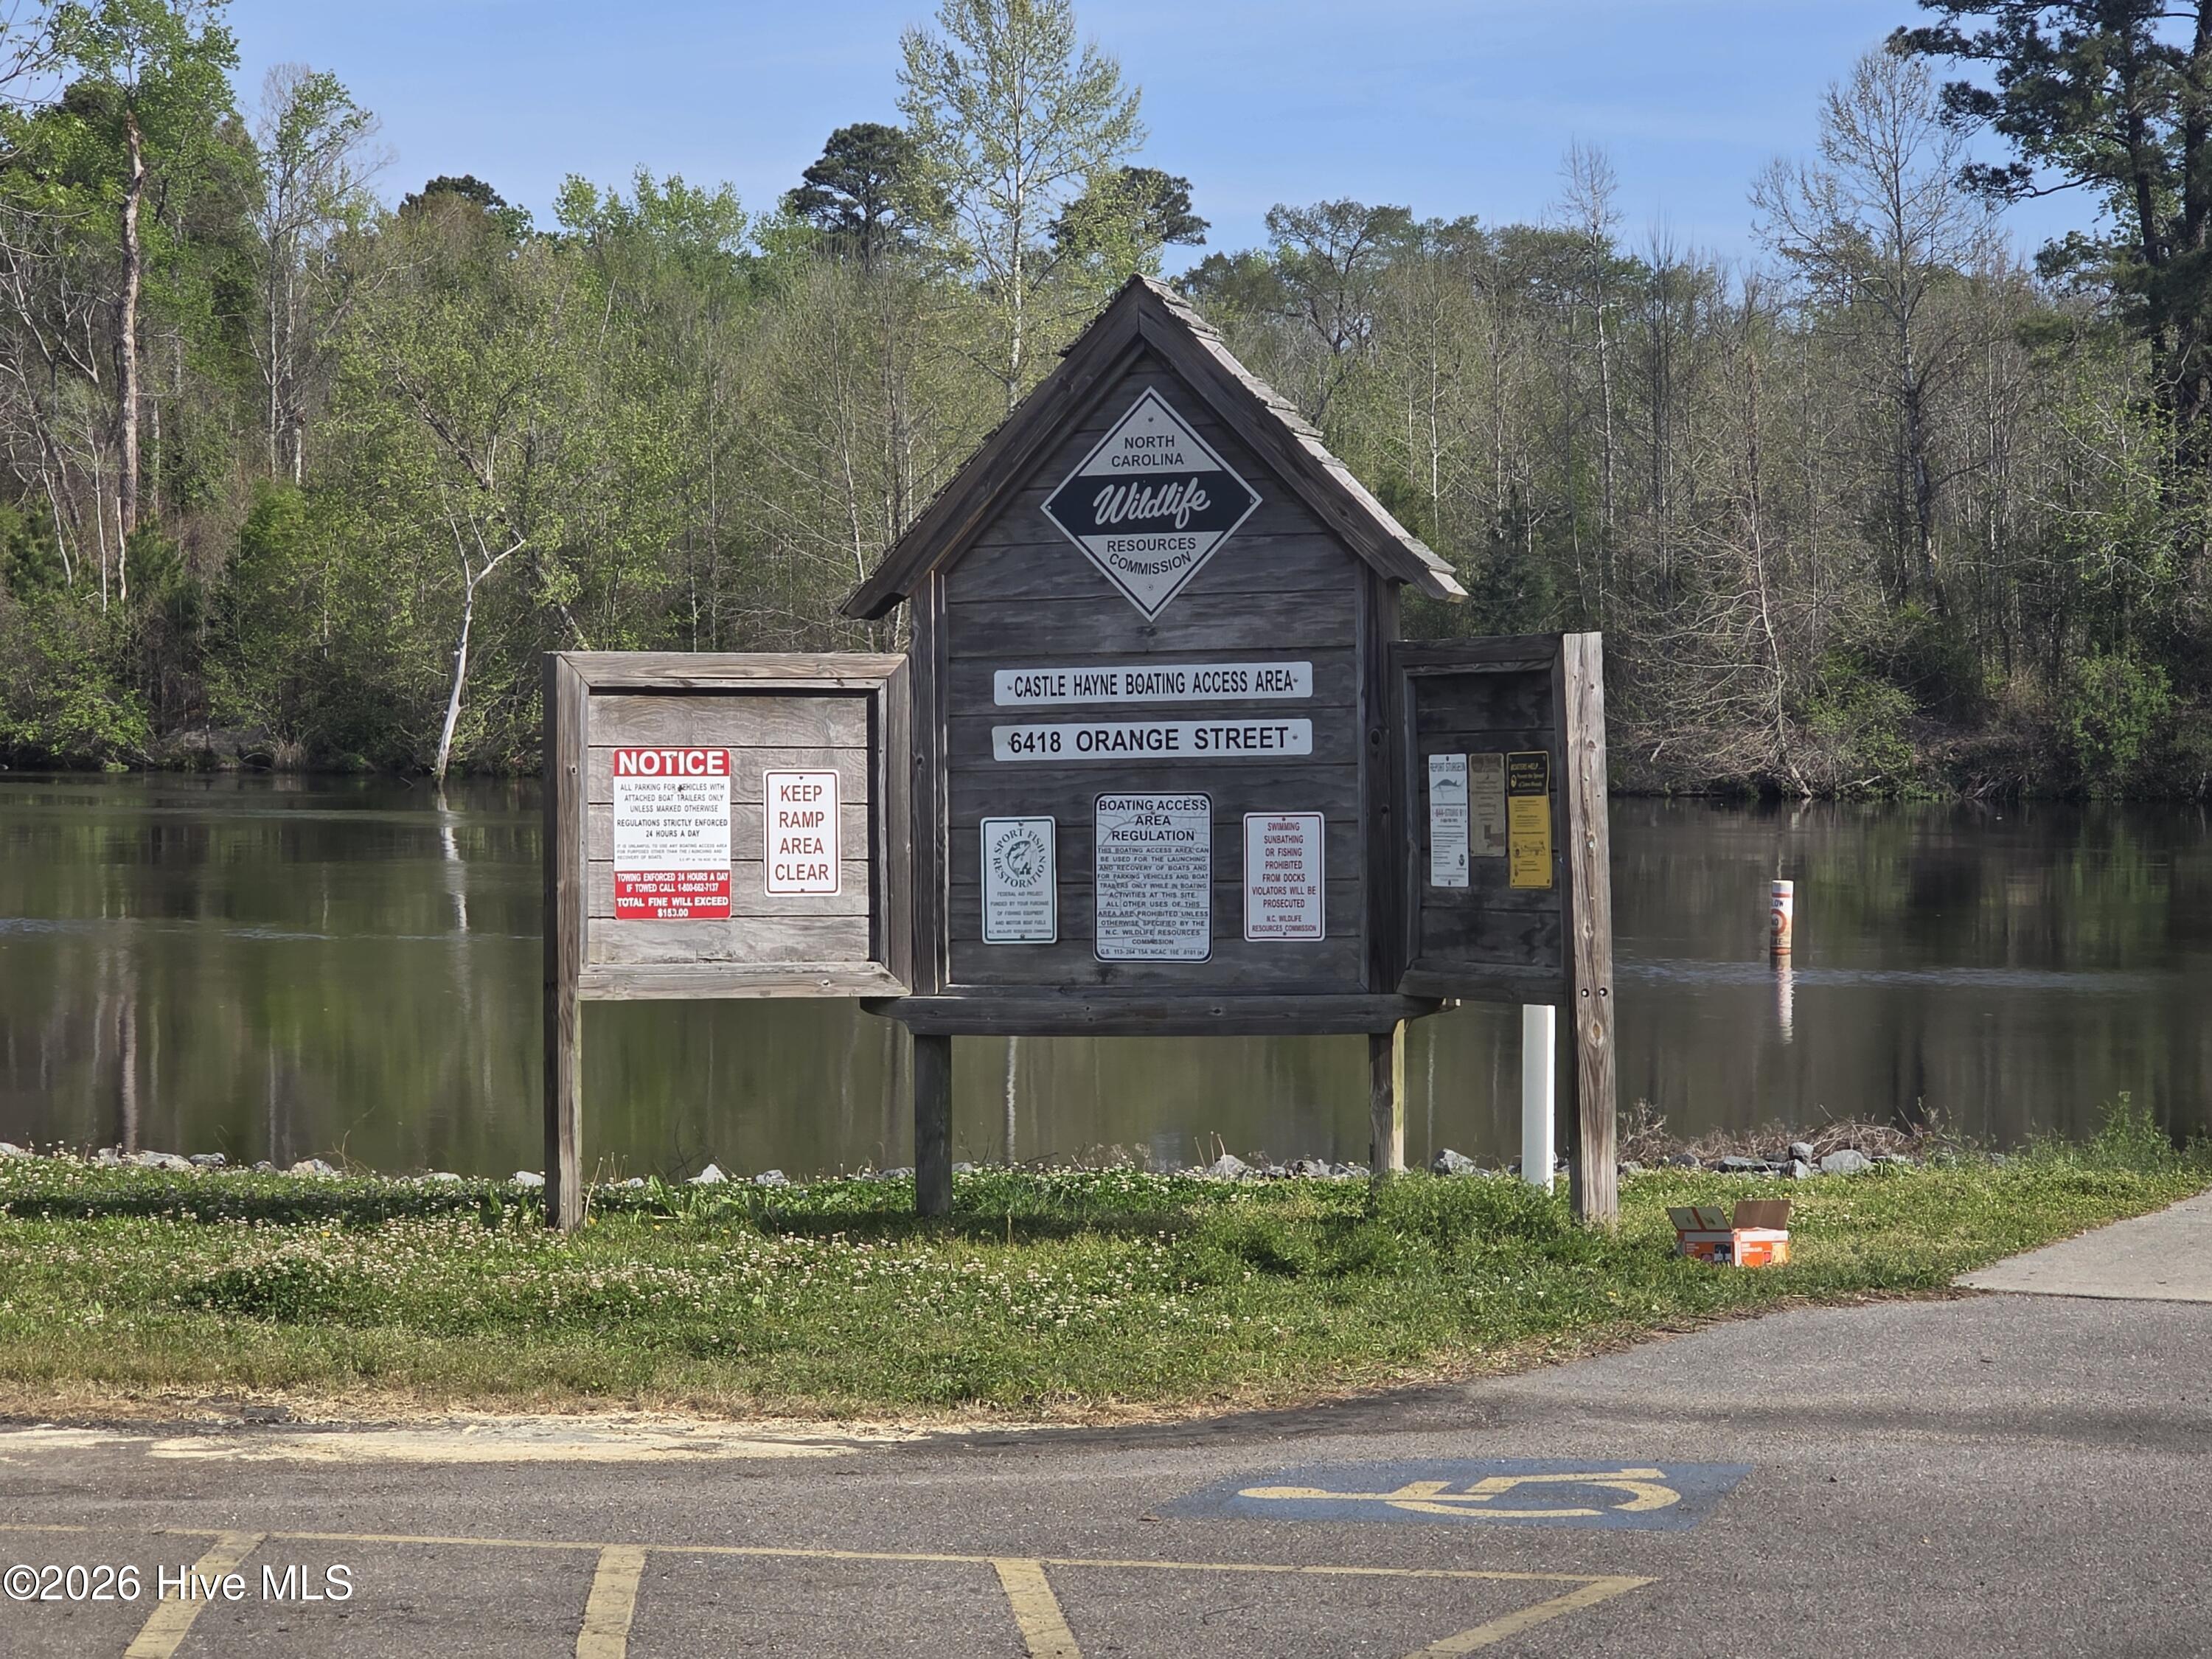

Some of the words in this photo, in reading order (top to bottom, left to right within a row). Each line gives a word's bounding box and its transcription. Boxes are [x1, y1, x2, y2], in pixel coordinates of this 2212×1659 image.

[1124, 435, 1175, 449] NORTH
[1111, 453, 1184, 467] CAROLINA
[1093, 477, 1211, 529] Wildlife
[1107, 538, 1196, 552] RESOURCES
[1109, 551, 1192, 575] COMMISSION
[1015, 675, 1065, 697] CASTLE
[1074, 675, 1117, 696] HAYNE
[1126, 672, 1185, 695] BOATING
[1192, 671, 1248, 693] ACCESS
[1255, 669, 1293, 692] AREA
[1011, 731, 1061, 753] 6418
[1077, 728, 1179, 751] ORANGE
[1194, 727, 1289, 749] STREET
[619, 751, 724, 774] NOTICE
[780, 785, 822, 802] KEEP
[1099, 800, 1153, 810] BOATING
[1157, 800, 1207, 810] ACCESS
[779, 811, 824, 828] RAMP
[1135, 815, 1171, 825] AREA
[1267, 822, 1299, 831] SWIMMING
[995, 828, 1024, 854] SPORT
[1028, 830, 1045, 853] FISH
[1112, 830, 1194, 841] REGULATION
[1264, 835, 1303, 844] SUNBATHING
[779, 838, 824, 854] AREA
[1265, 848, 1274, 857] OR
[1278, 848, 1302, 857] FISHING
[775, 863, 829, 880] CLEAR
[993, 855, 1046, 888] RESTORATION
[1265, 860, 1302, 869] PROHIBITED
[617, 873, 641, 882] TOWING
[644, 873, 675, 881] ENFORCED
[678, 873, 684, 881] 24
[687, 873, 708, 881] HOURS
[717, 872, 728, 880] DAY
[1262, 874, 1280, 883] FROM
[1284, 874, 1305, 882] DOCKS
[627, 884, 633, 892] IF
[636, 884, 657, 892] TOWED
[659, 883, 675, 891] CALL
[1252, 886, 1287, 895] VIOLATORS
[1290, 886, 1304, 895] WILL
[1307, 886, 1316, 894] BE
[617, 898, 644, 907] TOTAL
[648, 897, 667, 906] FINE
[672, 897, 692, 905] WILL
[695, 897, 728, 905] EXCEED
[1263, 899, 1304, 908] PROSECUTED
